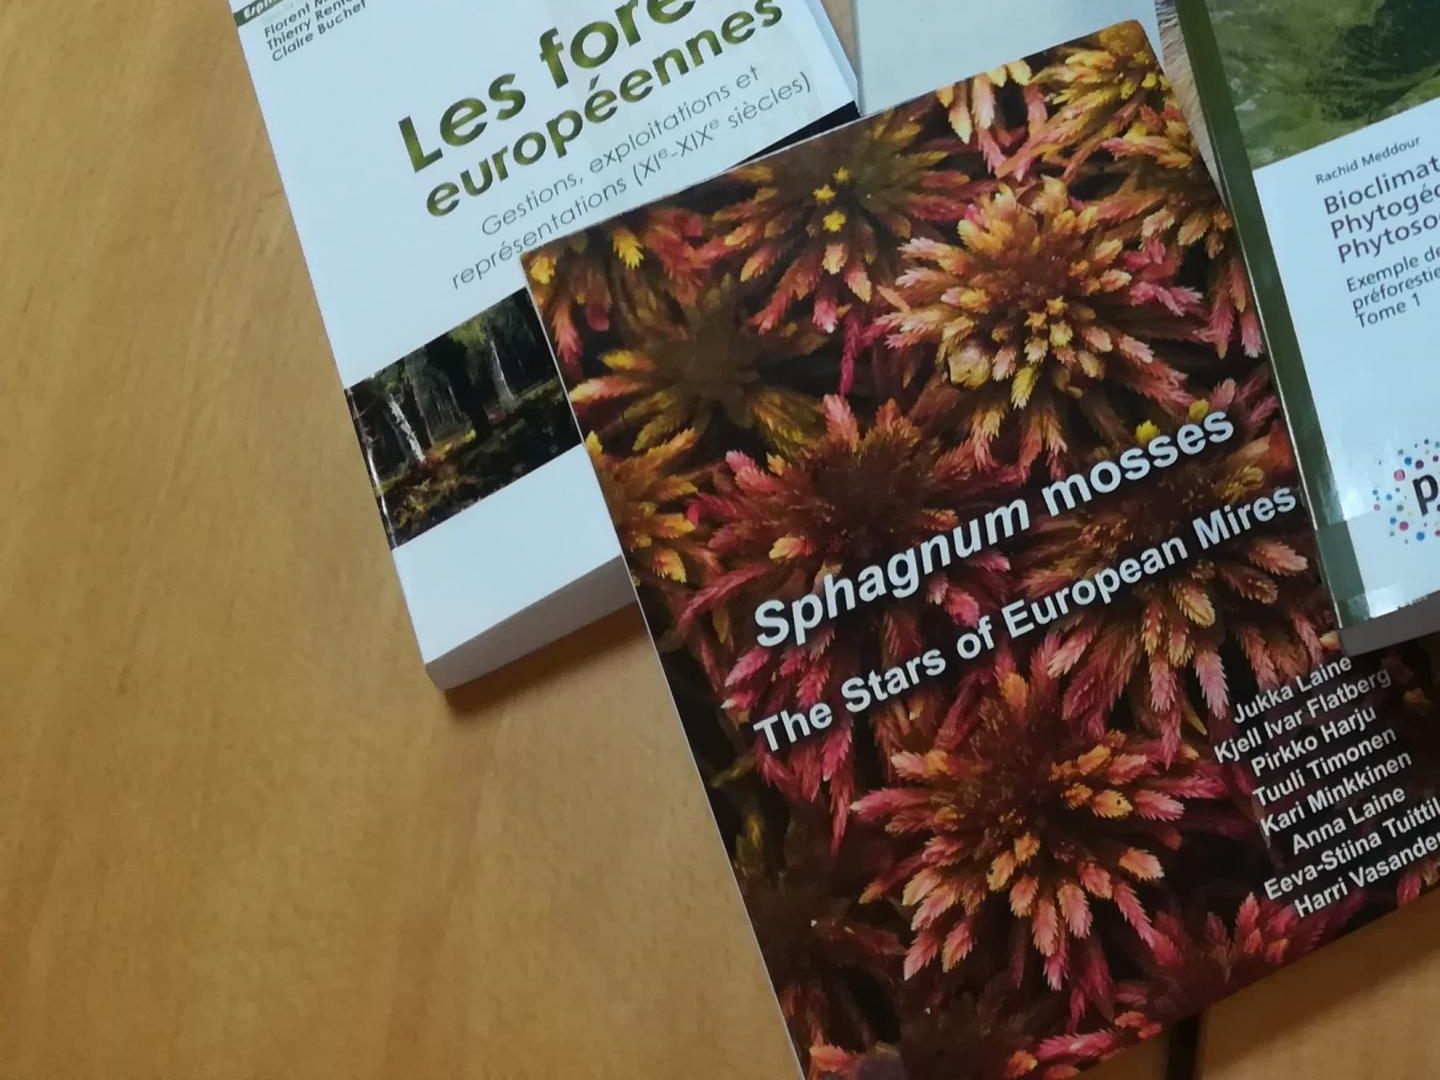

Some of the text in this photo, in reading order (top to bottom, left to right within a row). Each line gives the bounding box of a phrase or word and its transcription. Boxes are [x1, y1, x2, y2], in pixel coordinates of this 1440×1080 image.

[264, 3, 311, 38] Florent
[267, 18, 311, 50] Thierry
[272, 32, 313, 61] Claire
[398, 72, 527, 173] Les
[482, 65, 759, 236] Gestions, exploitations et
[452, 179, 627, 290] représentations
[728, 71, 812, 130] siècles)
[1316, 136, 1420, 185] Rachid Meddour
[1346, 255, 1420, 293] Exemple
[1355, 292, 1421, 329] Tome 1
[754, 410, 1235, 648] Sphagnum mosses
[753, 486, 1298, 752] The Stars of European Mires
[1214, 669, 1392, 763] Kjell Ivar Flatberg
[1234, 656, 1352, 724] Jukka Laine
[1251, 705, 1377, 777] Pirkko Harju
[1252, 727, 1397, 807] Tuuli Timonen
[1260, 751, 1412, 837] Kari Minkkinen
[1293, 788, 1405, 855] Anna Laine
[1264, 833, 1382, 900] Eeva-Stiina
[1295, 879, 1348, 917] Harri
